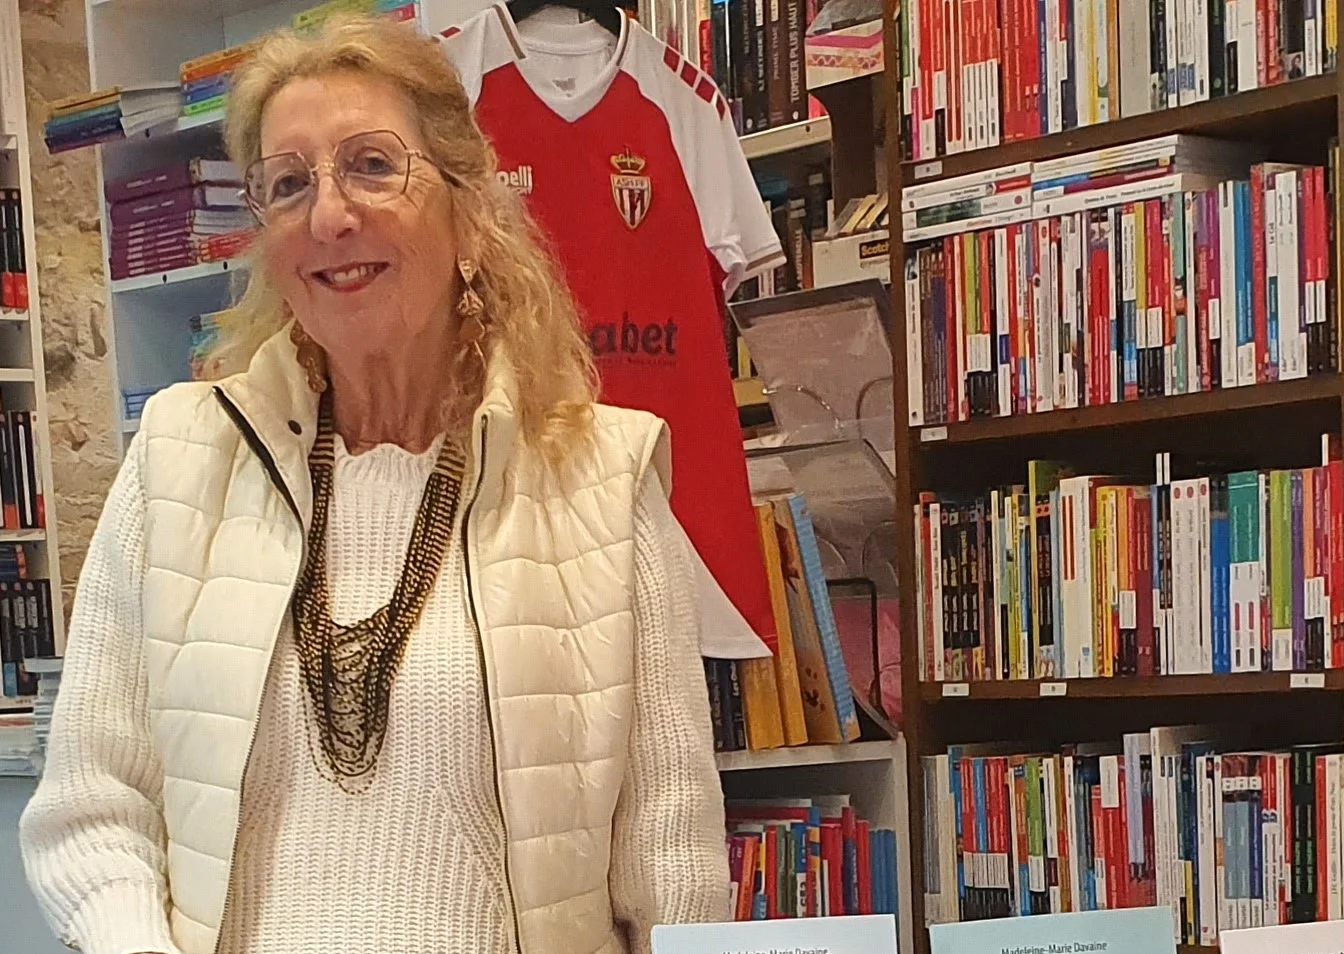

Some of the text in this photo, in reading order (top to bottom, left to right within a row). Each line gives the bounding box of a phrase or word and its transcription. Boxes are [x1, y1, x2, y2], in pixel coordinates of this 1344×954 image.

[788, 3, 800, 104] TOMBER PLUS HAUT
[1073, 940, 1108, 954] Davaine
